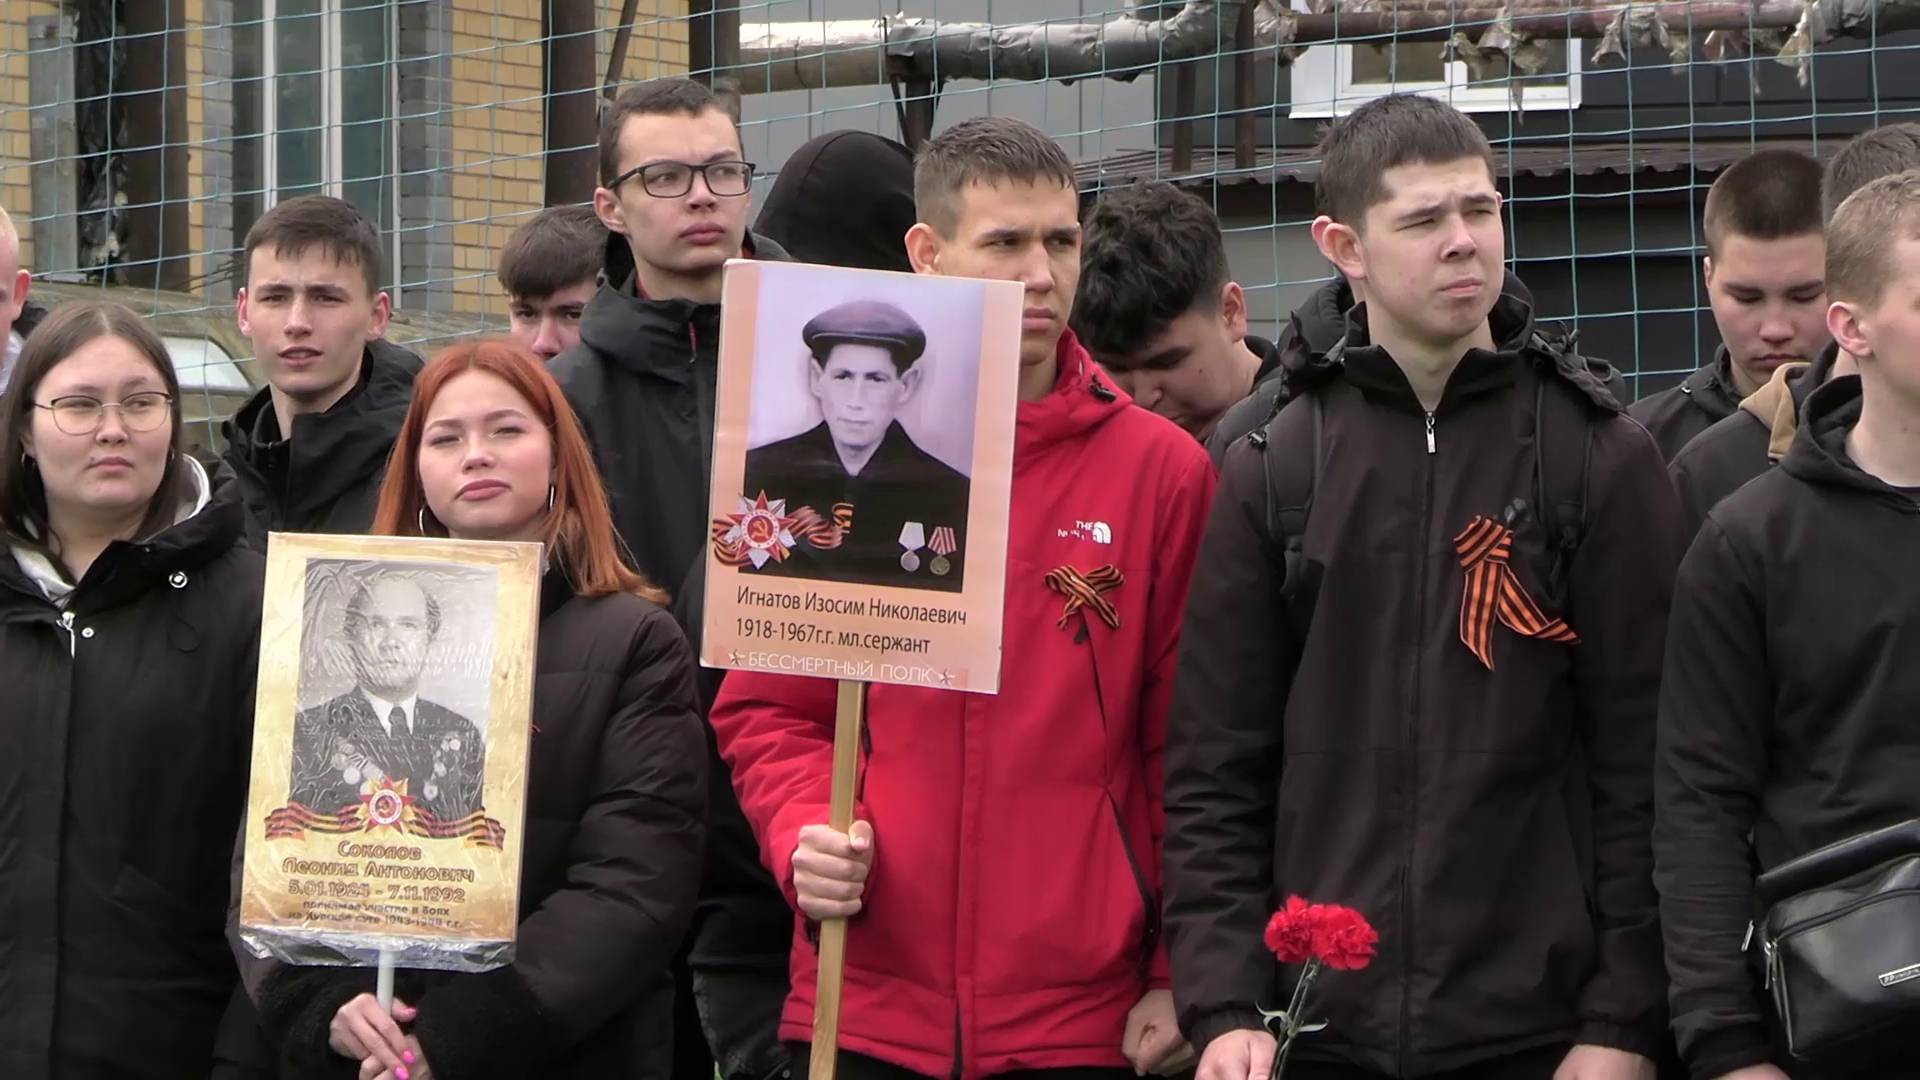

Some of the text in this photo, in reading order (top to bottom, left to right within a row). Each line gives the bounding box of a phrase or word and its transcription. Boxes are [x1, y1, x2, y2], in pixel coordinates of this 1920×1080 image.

[1076, 520, 1093, 531] THE
[737, 585, 967, 625] Игнатов Изосим Николаевич
[737, 617, 931, 654] 1918-1967г.г. мл.сержант
[748, 651, 932, 682] БЕССМЕРТНЫЙ ПОЛК
[337, 840, 422, 861] Соколов
[282, 857, 475, 883] Леонид Антонович
[387, 884, 465, 903] 7.11.1992
